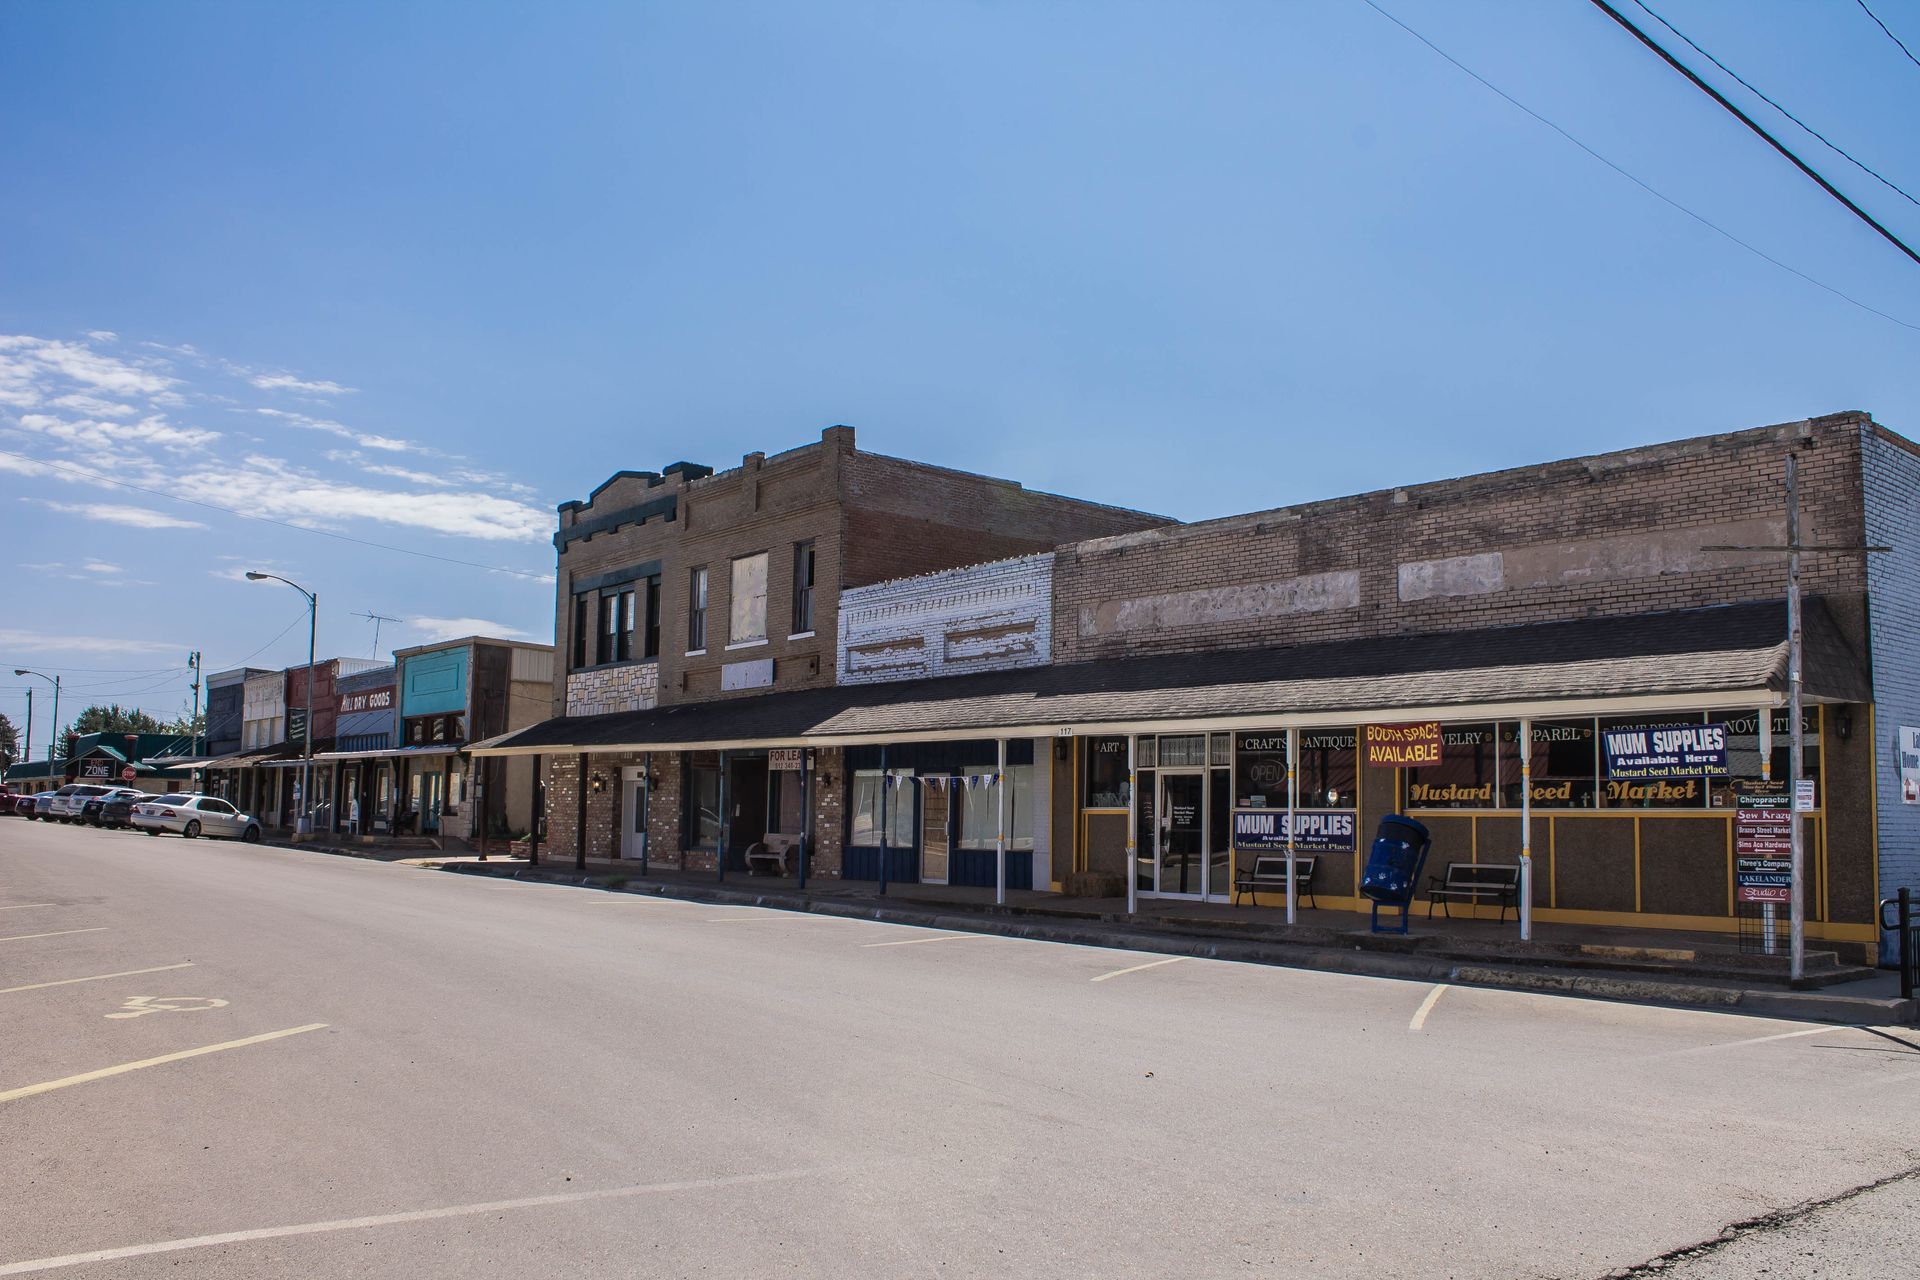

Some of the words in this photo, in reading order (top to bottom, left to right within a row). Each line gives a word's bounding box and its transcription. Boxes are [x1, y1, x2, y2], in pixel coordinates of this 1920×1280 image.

[354, 695, 367, 710] DRY
[369, 690, 390, 707] GOODS
[1367, 726, 1404, 742] BOOTH
[1403, 723, 1438, 741] SPACE
[1514, 728, 1580, 743] APAREL
[1100, 742, 1119, 752] ART
[1245, 737, 1287, 750] CRAFTS
[1607, 732, 1647, 755] MUM
[1653, 728, 1724, 753] SUPPLIES
[770, 750, 786, 761] FOR
[787, 750, 813, 761] LEA
[1370, 743, 1439, 762] AVAILABLE
[1617, 755, 1679, 766] Available
[1685, 754, 1718, 763] Here
[1902, 752, 1919, 769] Home
[85, 766, 110, 777] ZONE
[1250, 765, 1280, 781] OPEN
[1611, 768, 1647, 777] Mustard
[1648, 766, 1668, 776] Seed
[1671, 765, 1702, 775] Market
[1704, 764, 1728, 774] Place
[1410, 783, 1491, 801] Mustard
[1607, 780, 1699, 801] Market
[1740, 796, 1789, 804] Chiropractor
[1738, 810, 1758, 819] Sew
[1763, 810, 1791, 822] Krazy
[1237, 815, 1274, 834] MUM
[1744, 888, 1776, 897] Studio
[1780, 888, 1788, 897] C
